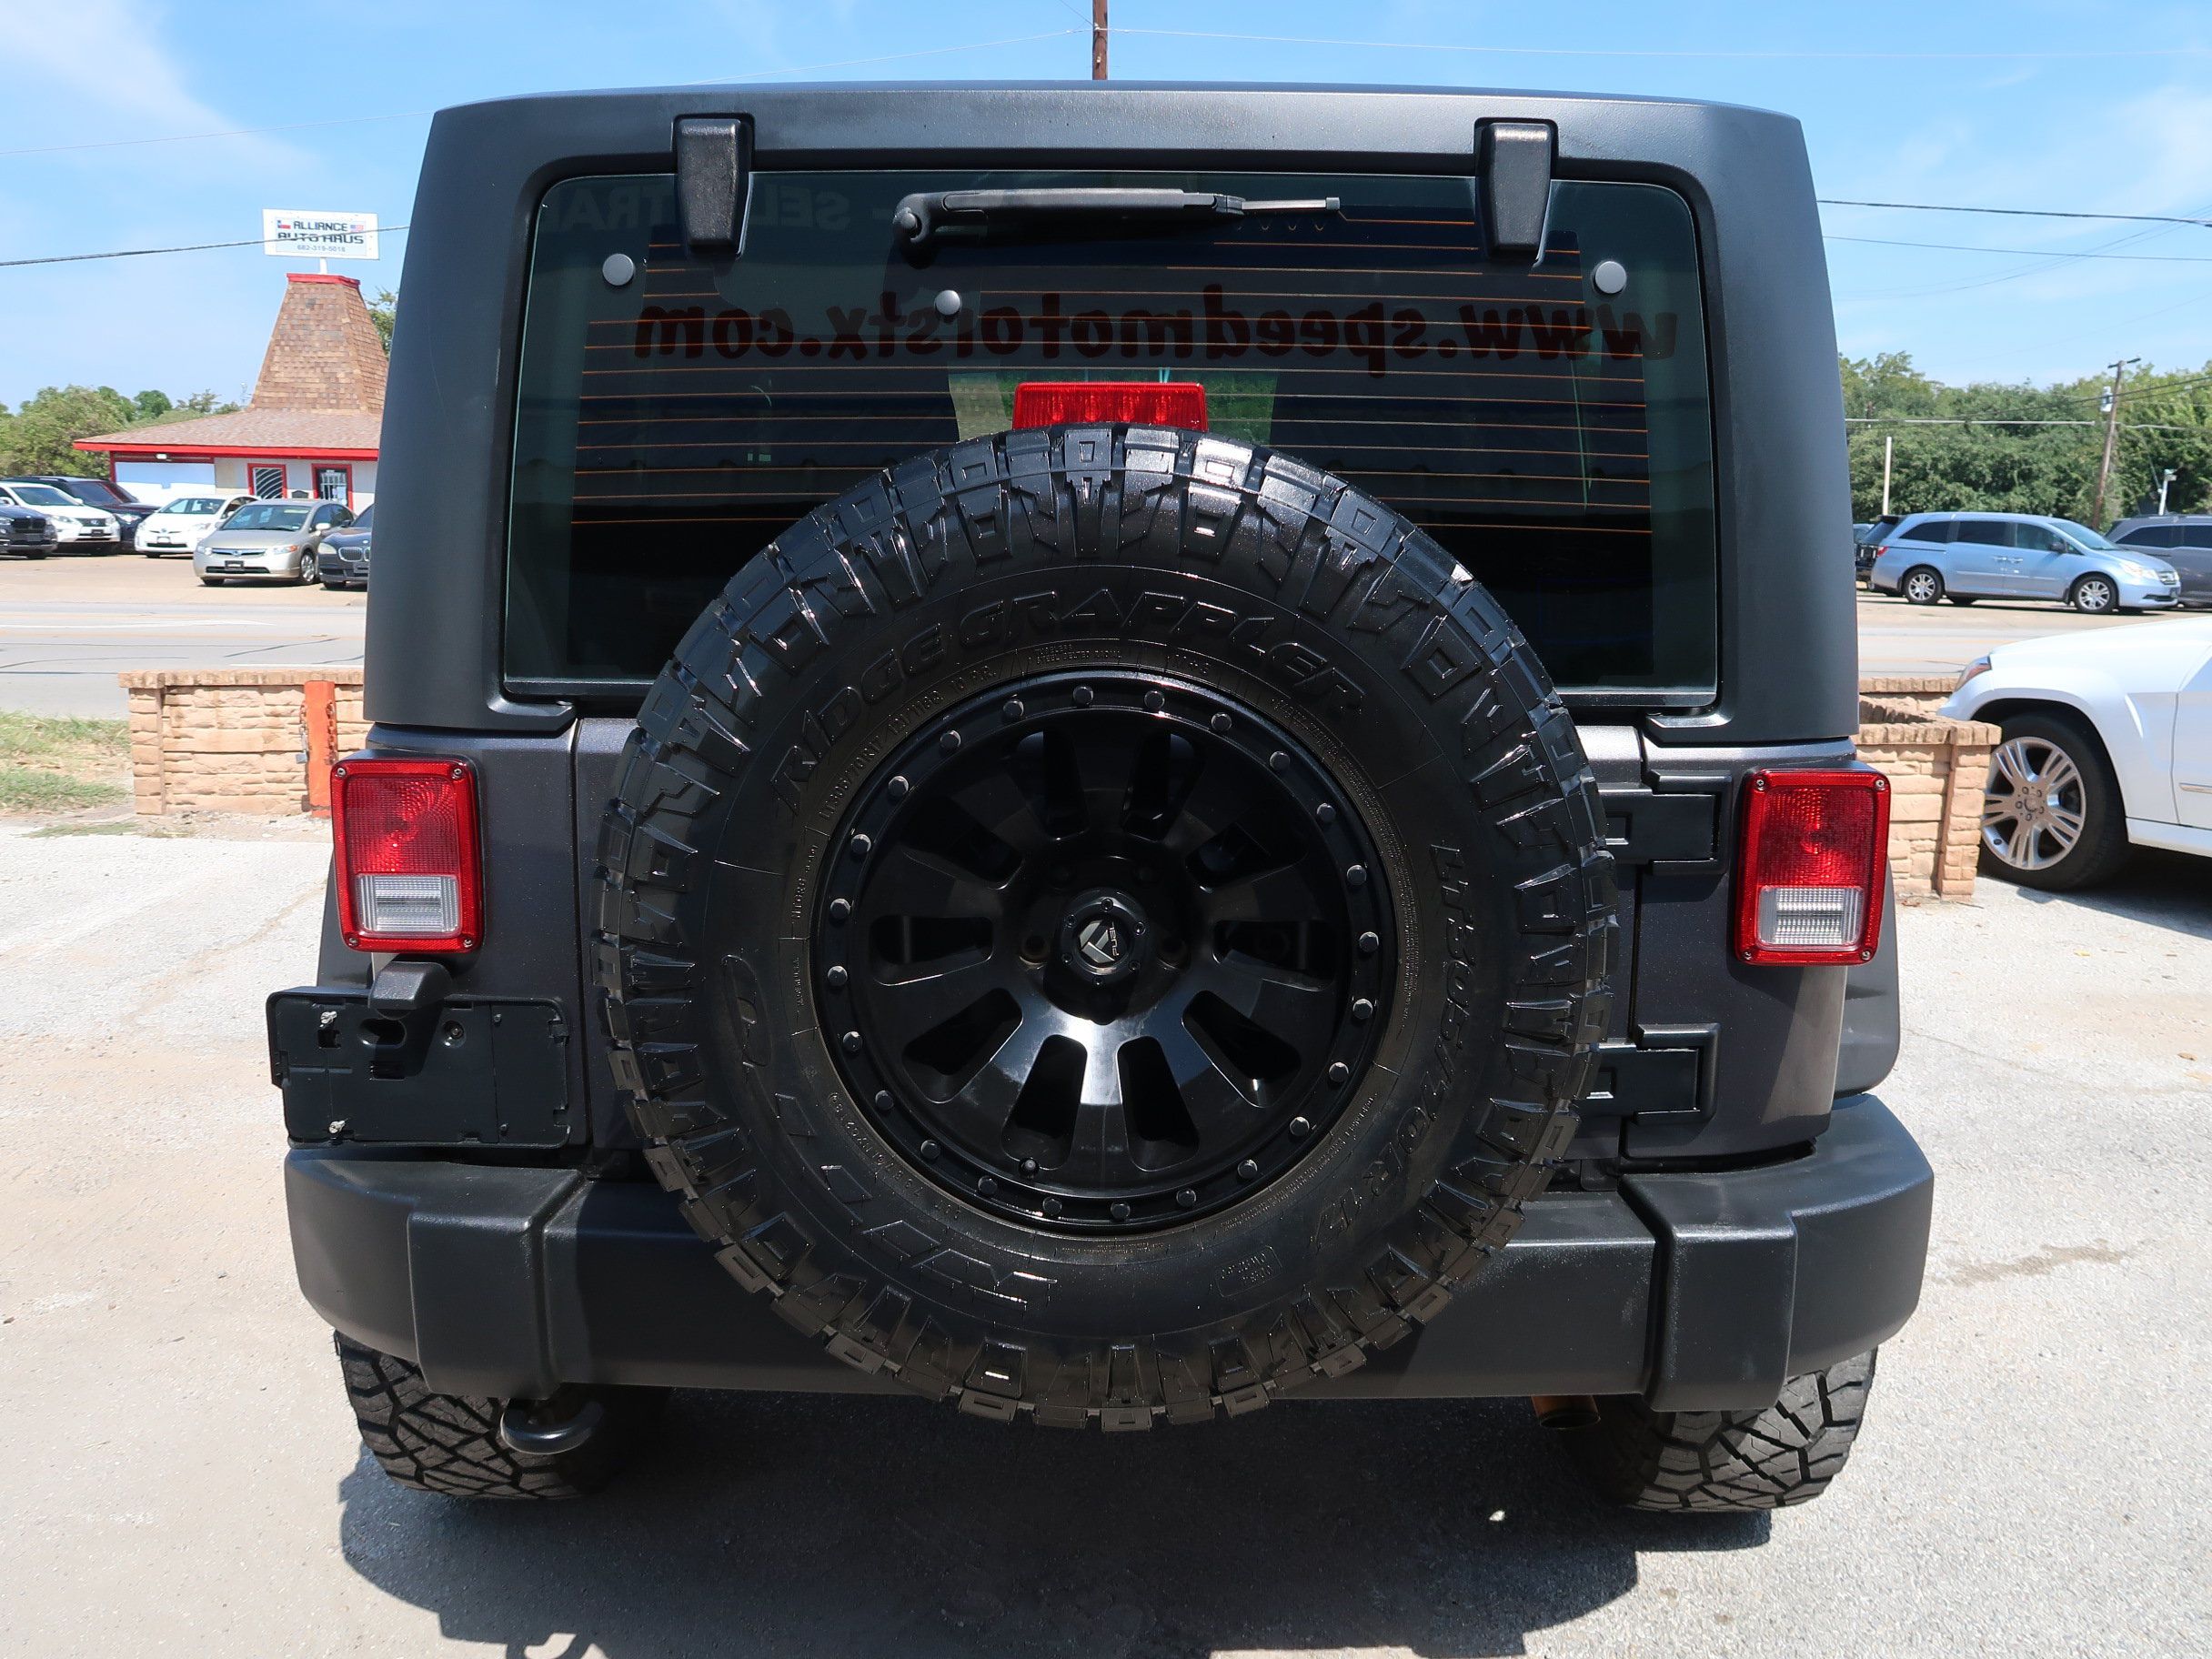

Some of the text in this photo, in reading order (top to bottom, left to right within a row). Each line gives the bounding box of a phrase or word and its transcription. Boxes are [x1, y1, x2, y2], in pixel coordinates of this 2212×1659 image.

[293, 220, 347, 231] ALLIANCE
[277, 232, 364, 244] AUTO HAUS
[769, 588, 1370, 816] RIDGE GRAPPLER
[1108, 920, 1121, 957] FUEL
